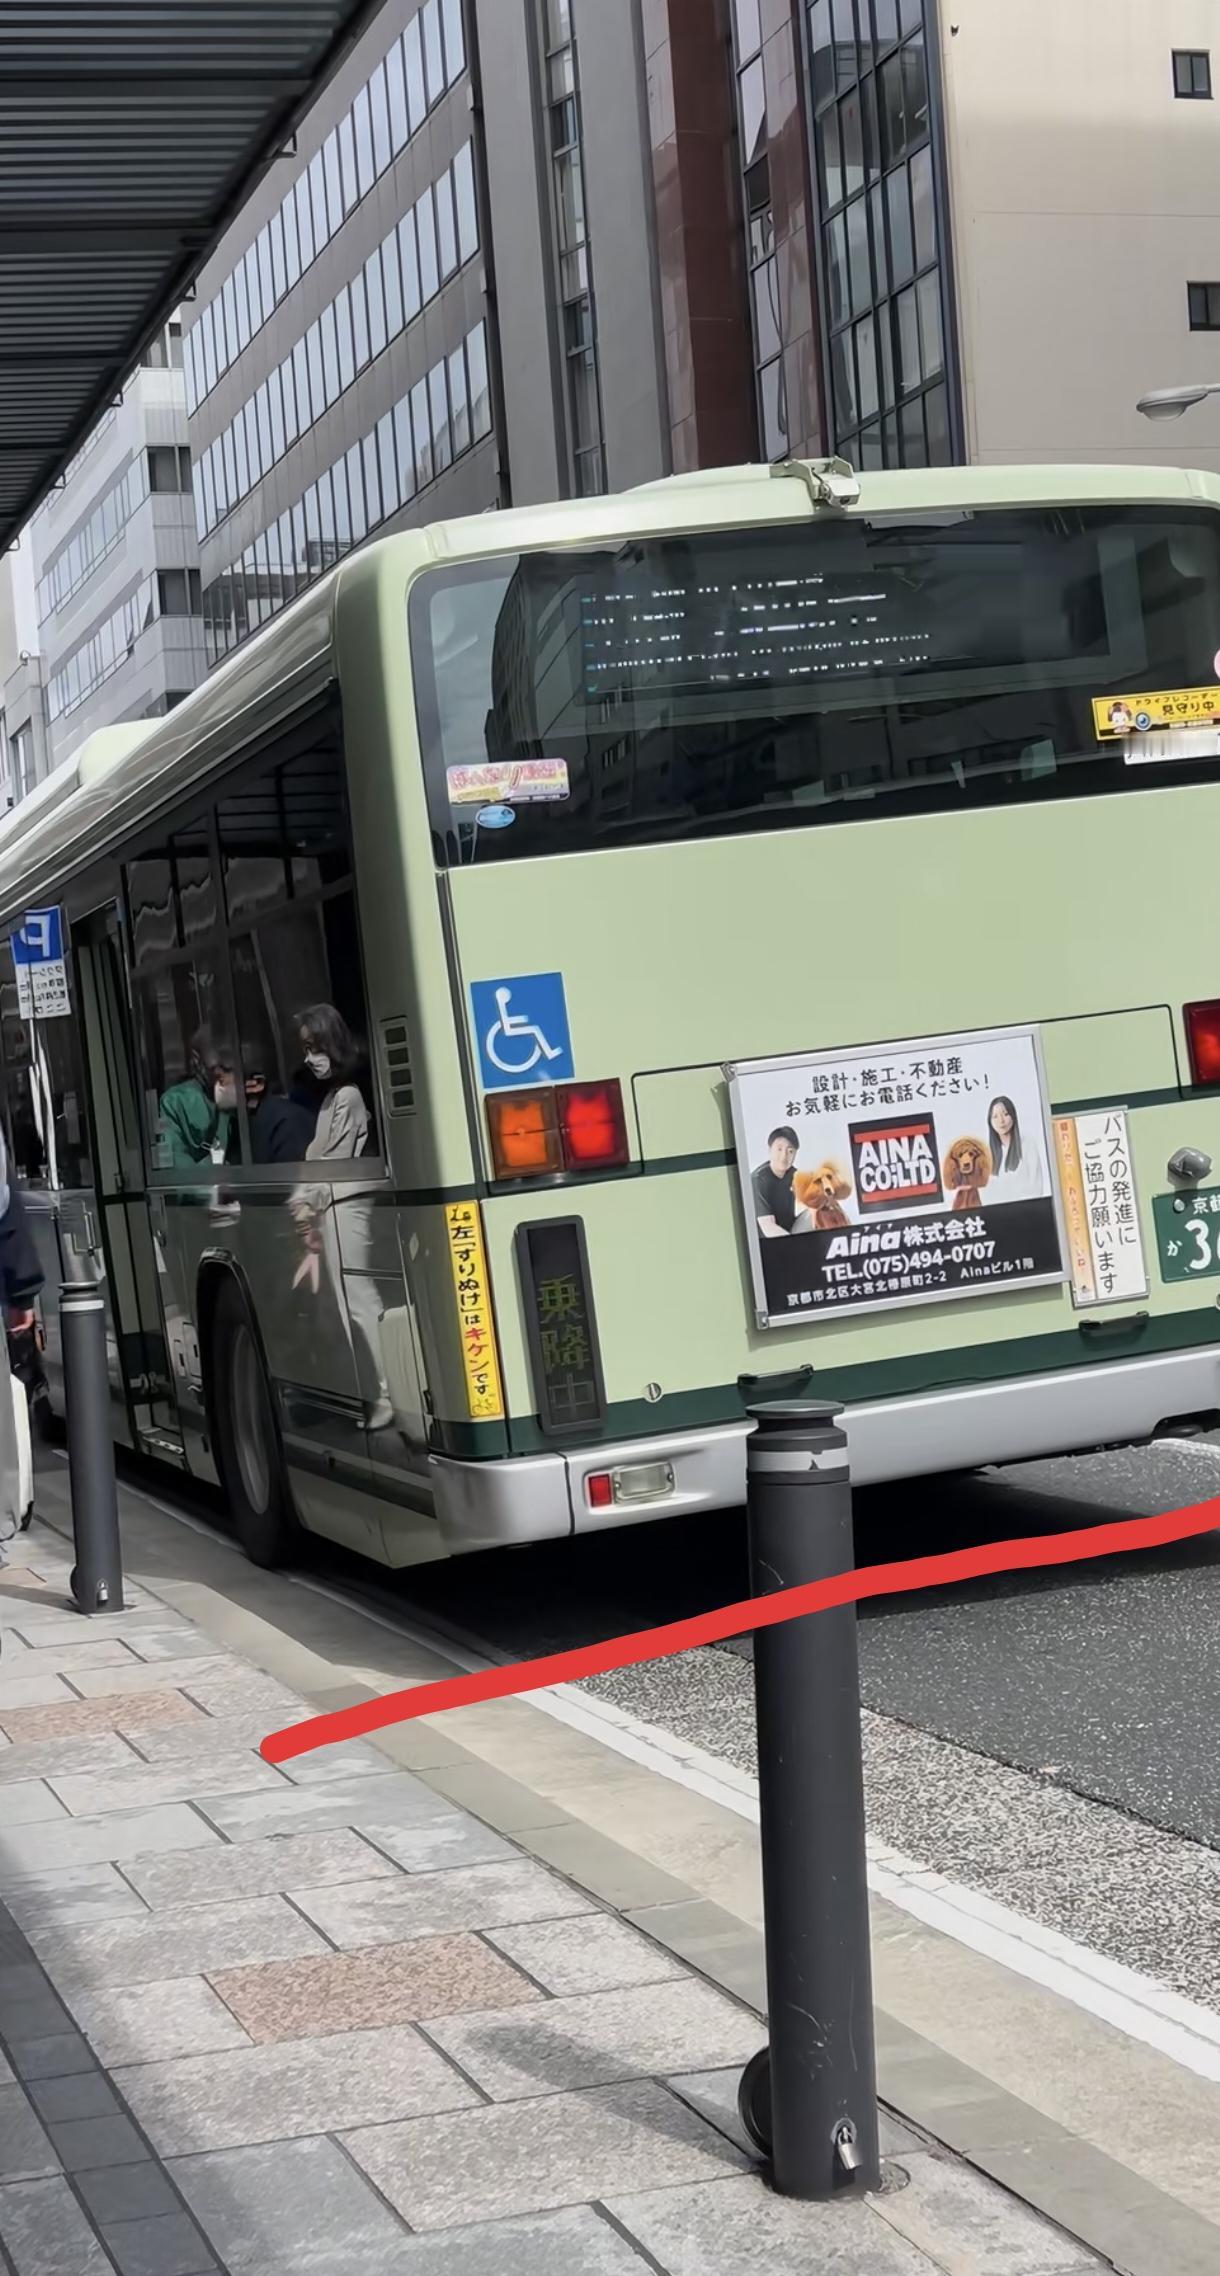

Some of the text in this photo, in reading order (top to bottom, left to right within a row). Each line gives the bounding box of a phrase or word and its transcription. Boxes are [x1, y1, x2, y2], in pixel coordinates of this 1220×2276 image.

[858, 1133, 934, 1168] AINA
[1104, 1115, 1137, 1246] バスの発進に
[1084, 1139, 1118, 1294] ご協力願います
[1167, 1218, 1220, 1271] か 3
[537, 1273, 596, 1421] 乗降中
